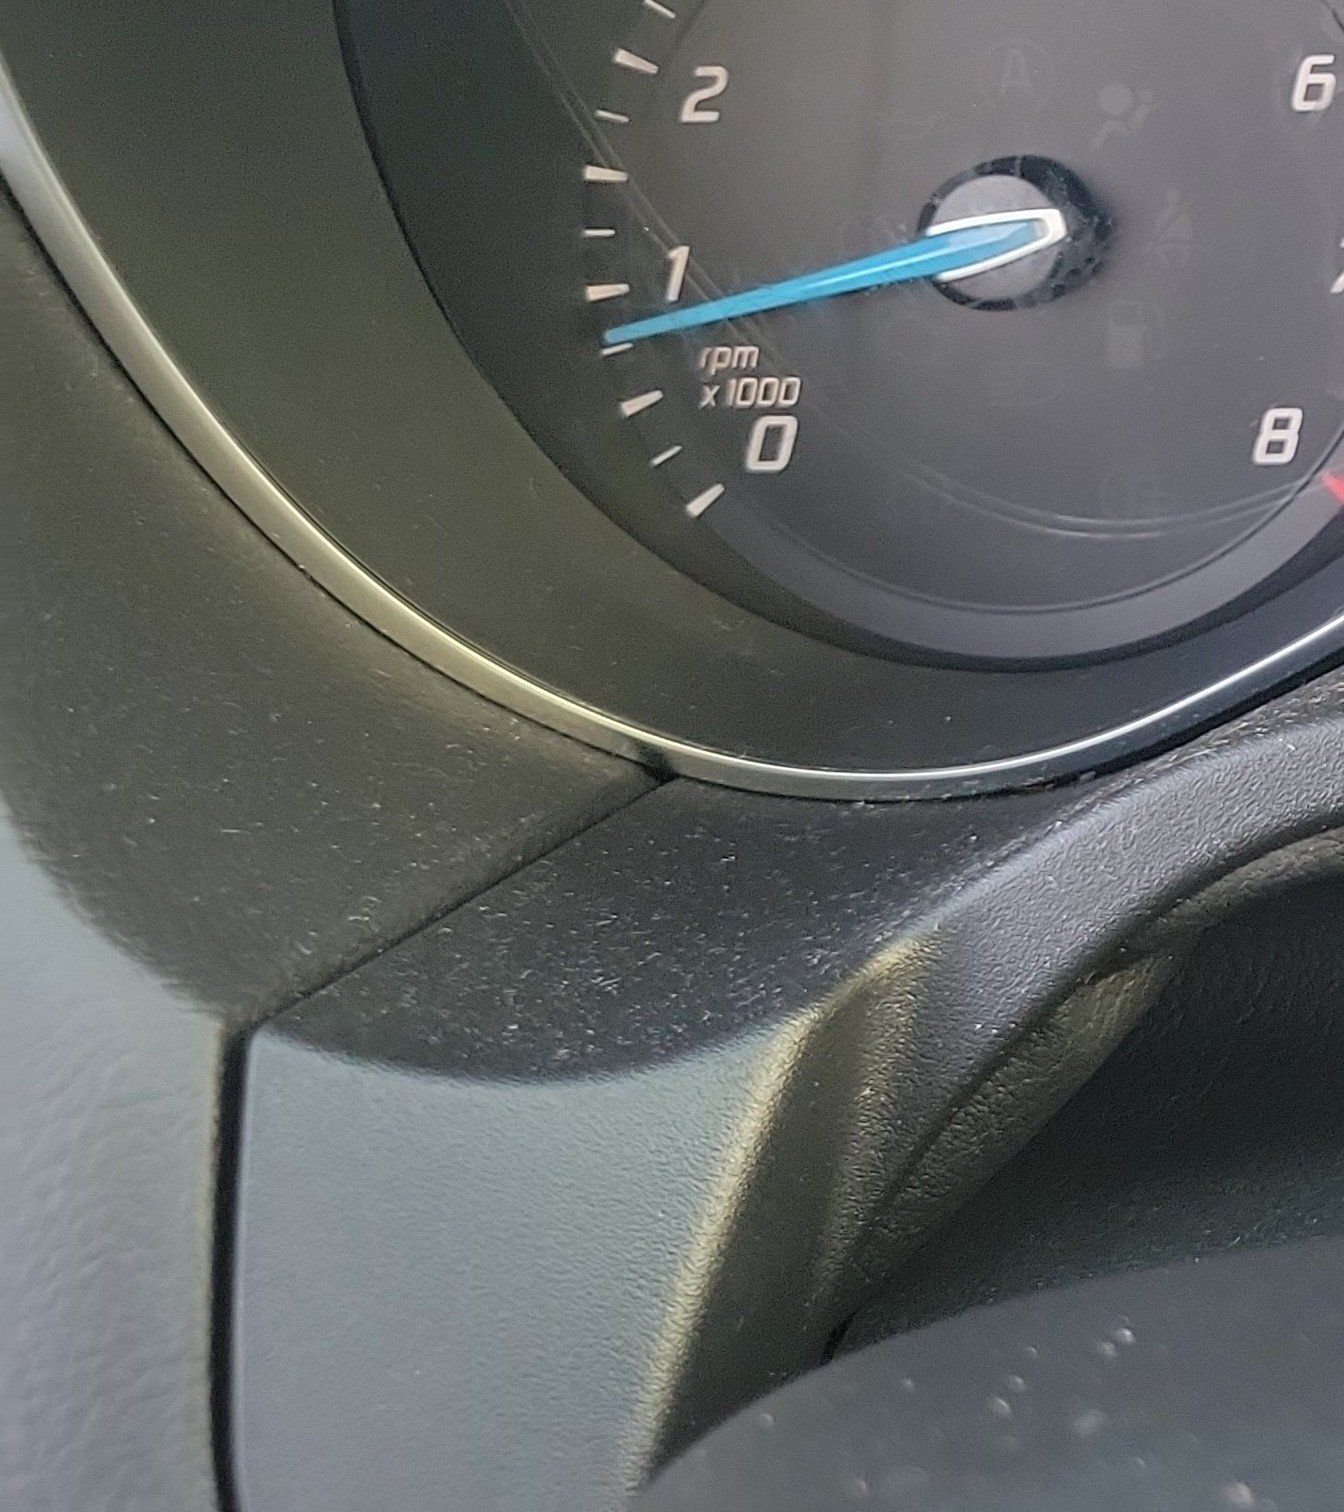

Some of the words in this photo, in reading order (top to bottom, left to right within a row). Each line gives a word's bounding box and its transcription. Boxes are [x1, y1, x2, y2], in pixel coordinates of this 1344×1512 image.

[681, 66, 727, 122] 2
[1293, 55, 1336, 110] 6
[667, 246, 689, 301] 1
[700, 346, 759, 375] rpm
[746, 416, 797, 471] 0
[1254, 408, 1302, 464] 8
